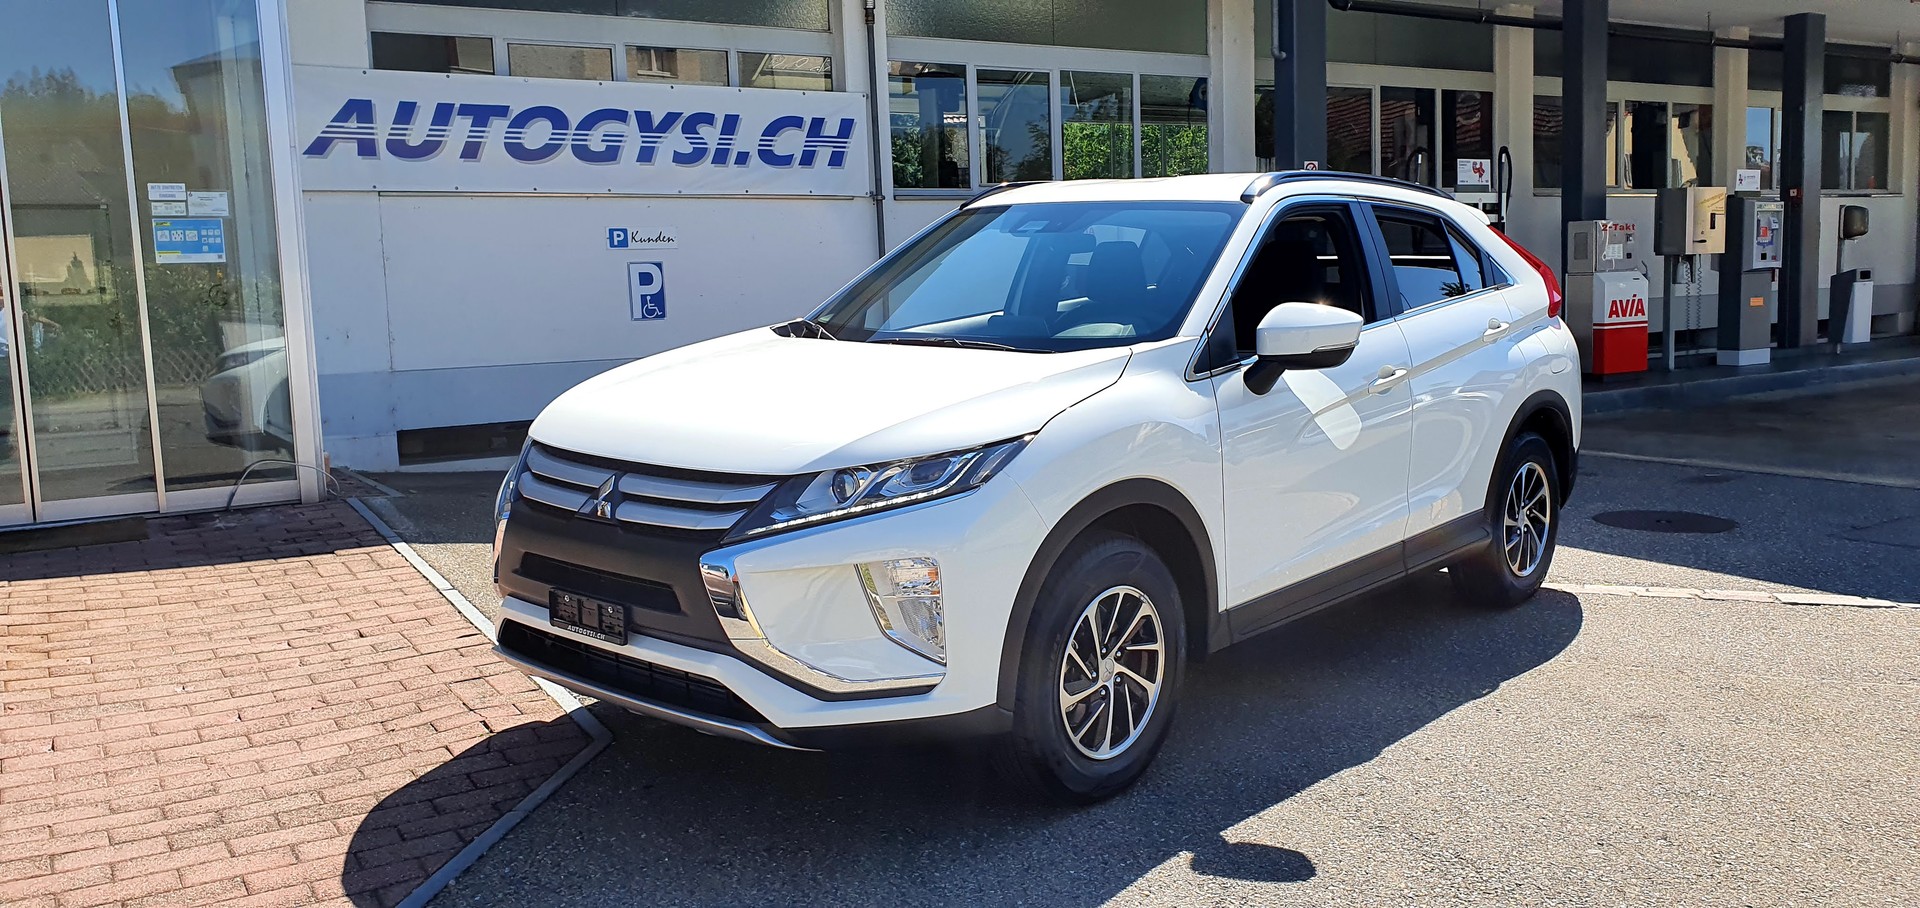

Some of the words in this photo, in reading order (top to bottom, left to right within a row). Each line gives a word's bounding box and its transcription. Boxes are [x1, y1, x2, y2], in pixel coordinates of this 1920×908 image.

[303, 98, 856, 169] AUTOGYSI.CH
[613, 230, 624, 245] P
[631, 230, 674, 243] Kunden
[1602, 223, 1636, 231] 2-Takt
[629, 263, 662, 318] P
